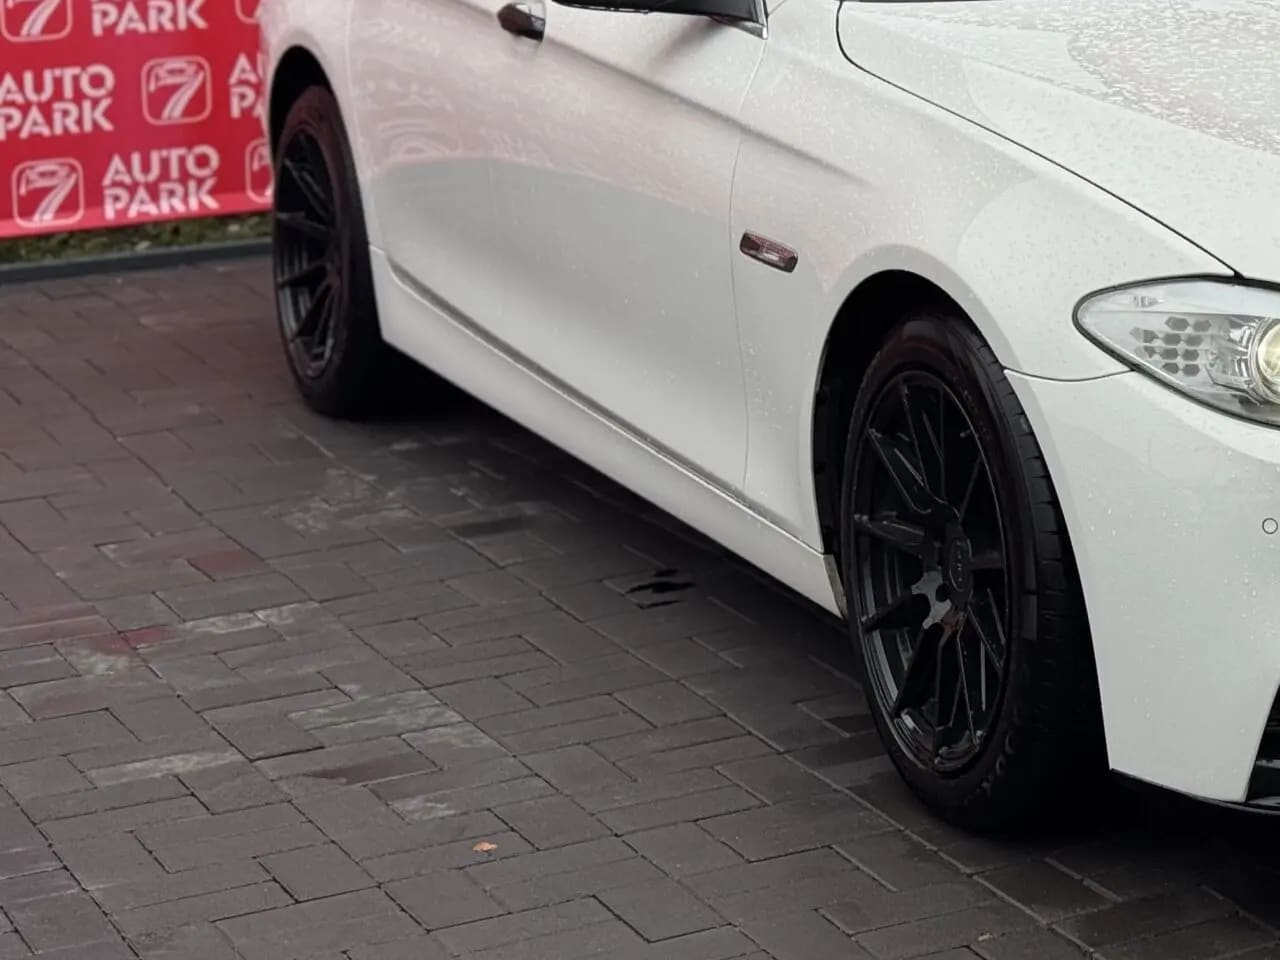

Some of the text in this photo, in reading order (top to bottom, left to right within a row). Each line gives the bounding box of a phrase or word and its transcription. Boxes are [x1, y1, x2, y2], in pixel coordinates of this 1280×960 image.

[0, 64, 115, 106] AUTO
[0, 97, 114, 141] PARK
[102, 144, 220, 187] AUTO
[104, 177, 220, 221] PARK
